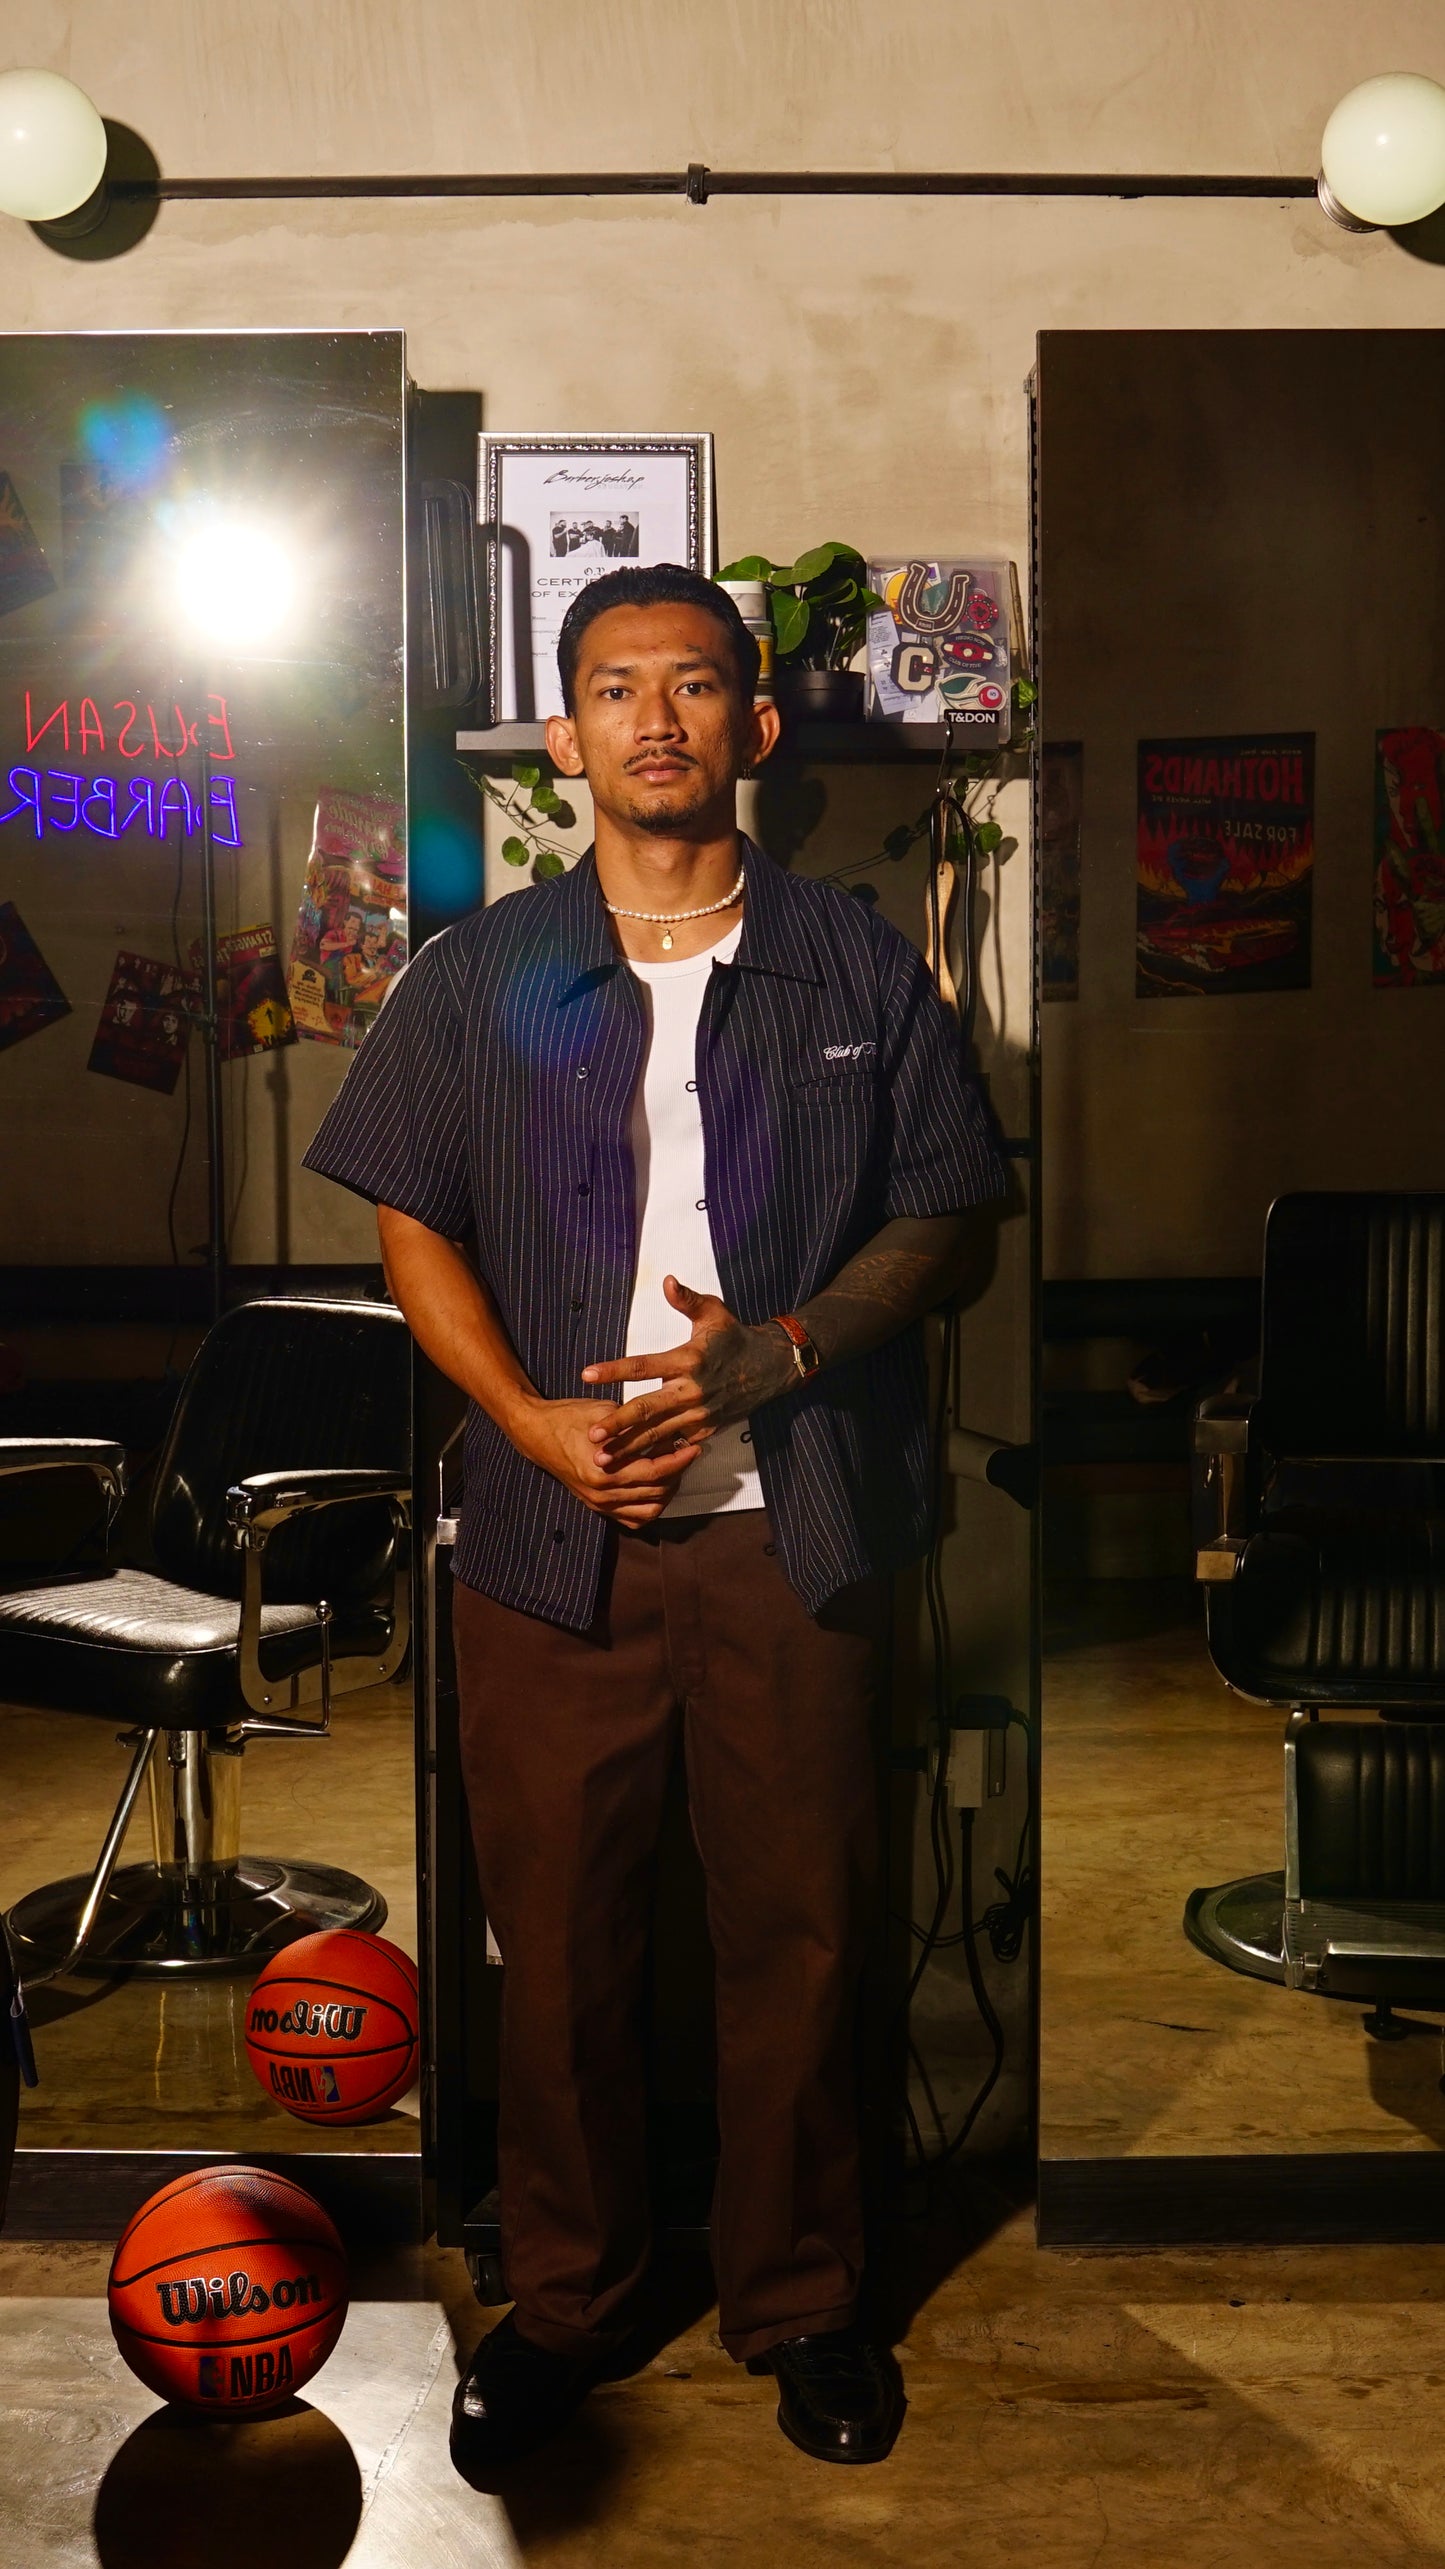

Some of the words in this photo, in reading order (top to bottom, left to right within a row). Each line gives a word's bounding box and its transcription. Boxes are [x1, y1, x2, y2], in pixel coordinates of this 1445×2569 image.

[948, 712, 996, 723] T&DON
[823, 1044, 853, 1060] Club
[155, 2270, 323, 2326] Wilson
[230, 2345, 294, 2399] NBA
